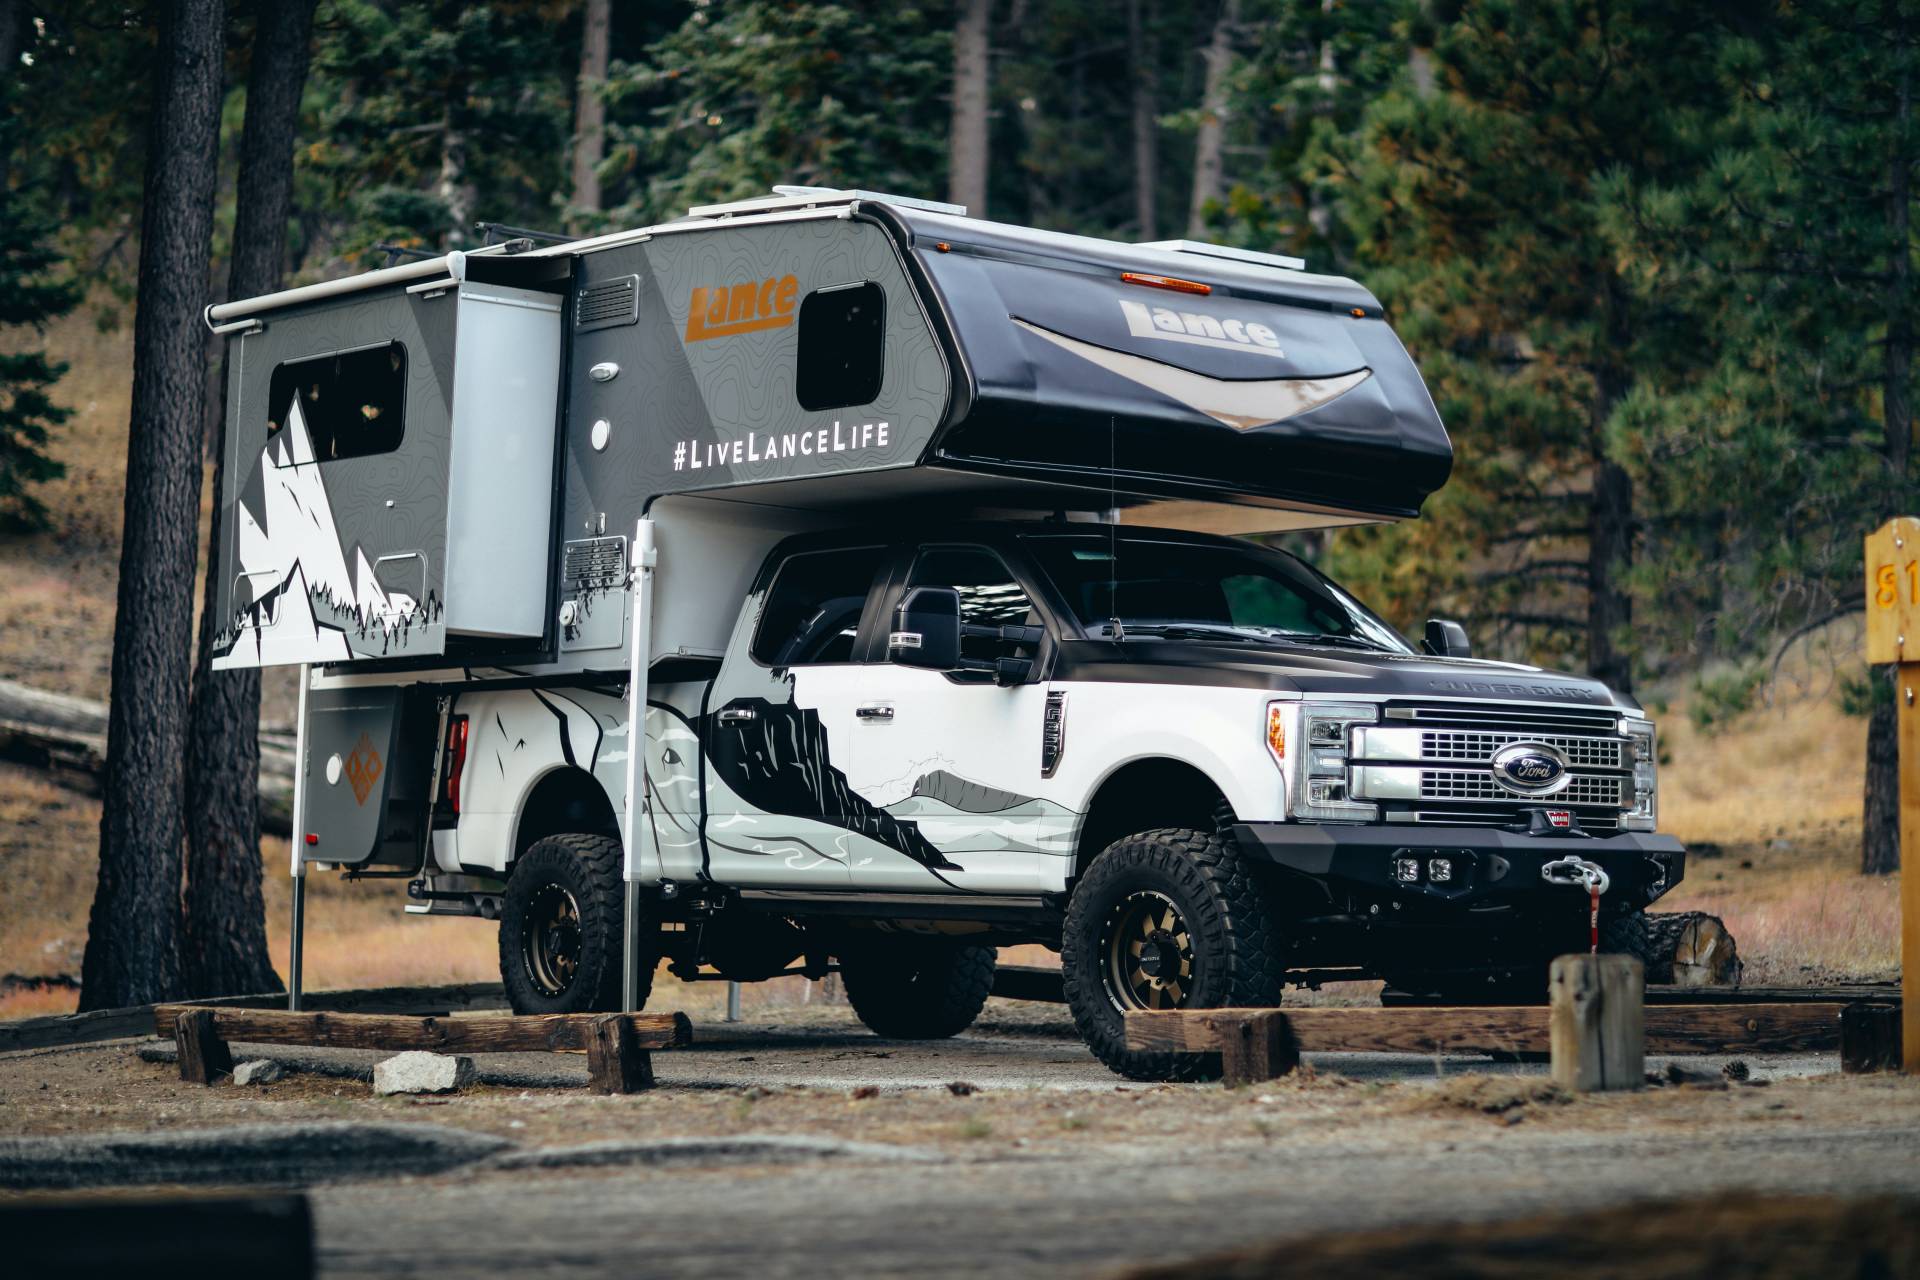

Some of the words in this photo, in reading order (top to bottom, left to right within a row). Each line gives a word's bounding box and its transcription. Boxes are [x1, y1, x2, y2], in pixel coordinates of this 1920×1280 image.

[684, 274, 798, 343] Lance
[1118, 299, 1285, 359] Lance
[1875, 560, 1919, 608] 81
[1518, 759, 1551, 777] Ford
